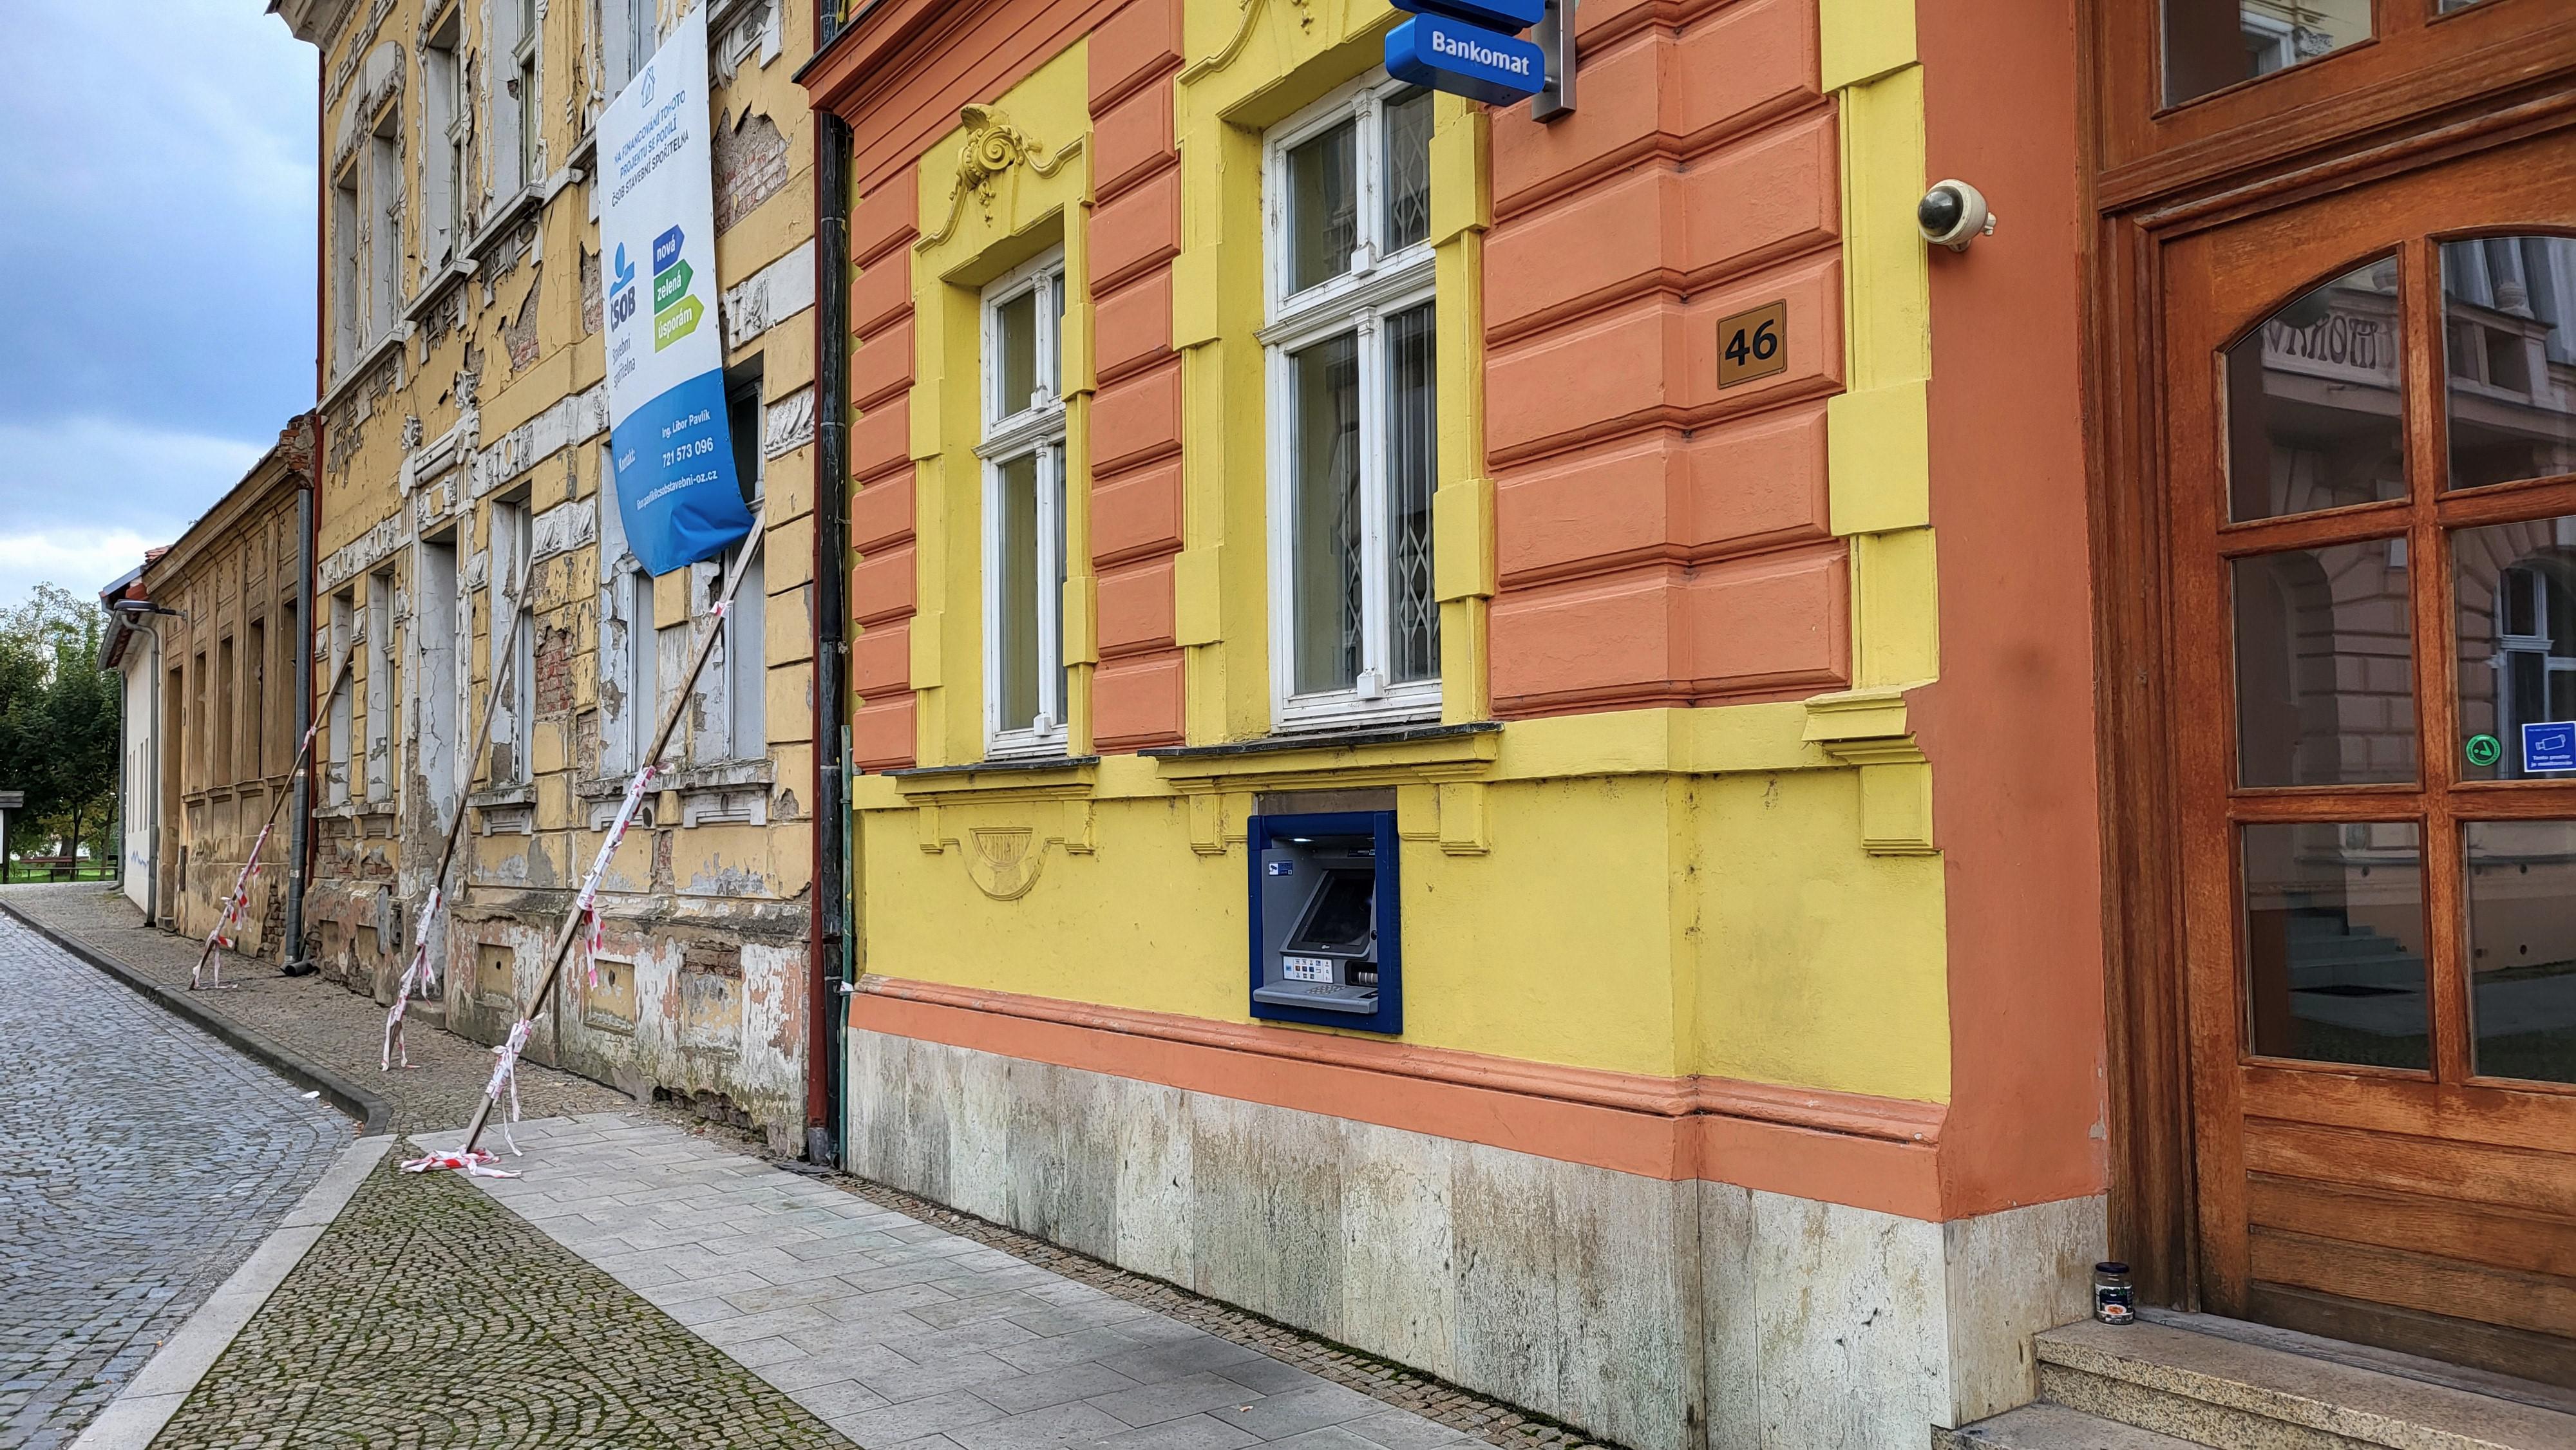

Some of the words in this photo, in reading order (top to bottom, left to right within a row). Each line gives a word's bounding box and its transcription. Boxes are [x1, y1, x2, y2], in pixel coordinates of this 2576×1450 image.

[1432, 30, 1530, 76] Bankomat
[622, 108, 660, 158] FINANCOVÁNÍ
[661, 89, 686, 121] TOHOTO
[612, 185, 625, 207] ČSOB
[625, 158, 651, 194] STAVEBNÍ
[652, 129, 689, 170] SPOŘITELNA
[620, 144, 648, 179] PROJEKTU
[648, 137, 655, 153] SE
[656, 238, 676, 262] nová
[657, 268, 682, 302] zelená
[658, 305, 692, 339] úsporám
[1725, 319, 1778, 366] 46
[614, 357, 636, 390] spořitelna
[662, 426, 672, 438] Ing.
[672, 419, 687, 433] Libor
[689, 409, 710, 426] Pavlík
[618, 447, 636, 474] Kontakt:
[662, 451, 674, 468] 721
[677, 443, 692, 462] 573
[695, 437, 714, 455] 096
